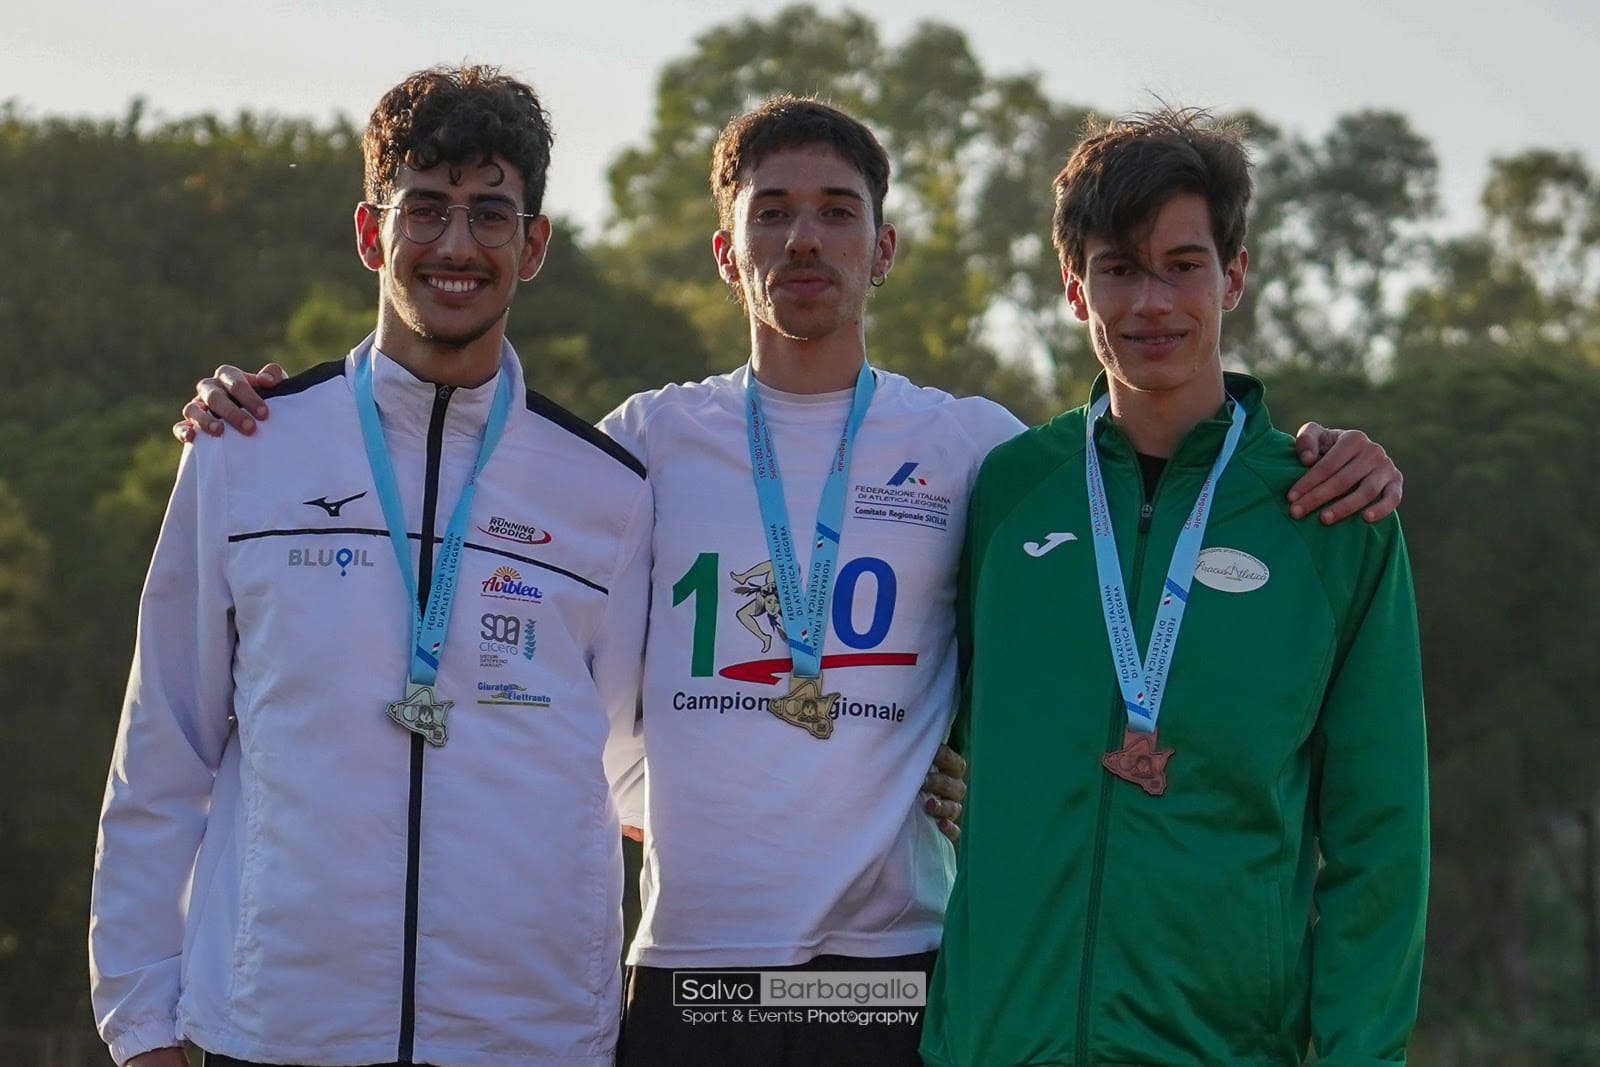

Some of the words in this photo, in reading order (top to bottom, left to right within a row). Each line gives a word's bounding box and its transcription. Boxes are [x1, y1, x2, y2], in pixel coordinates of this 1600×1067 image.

[855, 485, 916, 497] FEDERAZIONE
[917, 492, 951, 505] ITALIANA
[869, 495, 910, 504] ATLETICA
[910, 499, 948, 511] LEGGERA
[489, 516, 536, 535] RUNNING
[855, 506, 887, 516] Comitato
[889, 509, 924, 521] Regionale
[925, 514, 947, 526] SICILIA
[488, 525, 533, 541] MODICA
[770, 523, 783, 561] ITALIANA
[780, 526, 793, 563] LEGGERA
[288, 548, 375, 569] BLUOIL
[449, 536, 462, 574] LEGGERA
[814, 562, 821, 572] DI
[427, 572, 445, 631] FEDERAZIONE
[441, 531, 455, 570] ITALIANA
[439, 577, 453, 615] ATLETICA
[481, 576, 543, 599] Aviblea
[780, 563, 795, 621] FEDERAZIONE
[788, 565, 802, 608] ATLETICA
[809, 574, 819, 616] ATLETICA
[818, 559, 831, 617] FEDERAZIONE
[796, 607, 803, 616] DI
[1104, 584, 1117, 623] ITALIANA
[1114, 586, 1127, 625] LEGGERA
[437, 616, 445, 628] DI
[812, 620, 821, 652] ITALIA
[1159, 620, 1166, 630] DI
[1111, 626, 1129, 684] FEDERAZIONE
[1122, 627, 1136, 667] ATLETICA
[1148, 633, 1163, 672] ATLETICA
[1156, 617, 1176, 676] FEDERAZIONE
[477, 682, 509, 692] Giurato
[1131, 668, 1138, 679] DI
[508, 691, 551, 703] Elettrauto
[673, 692, 770, 713] Campion
[829, 702, 905, 722] gionale
[1149, 679, 1161, 714] ITALIA
